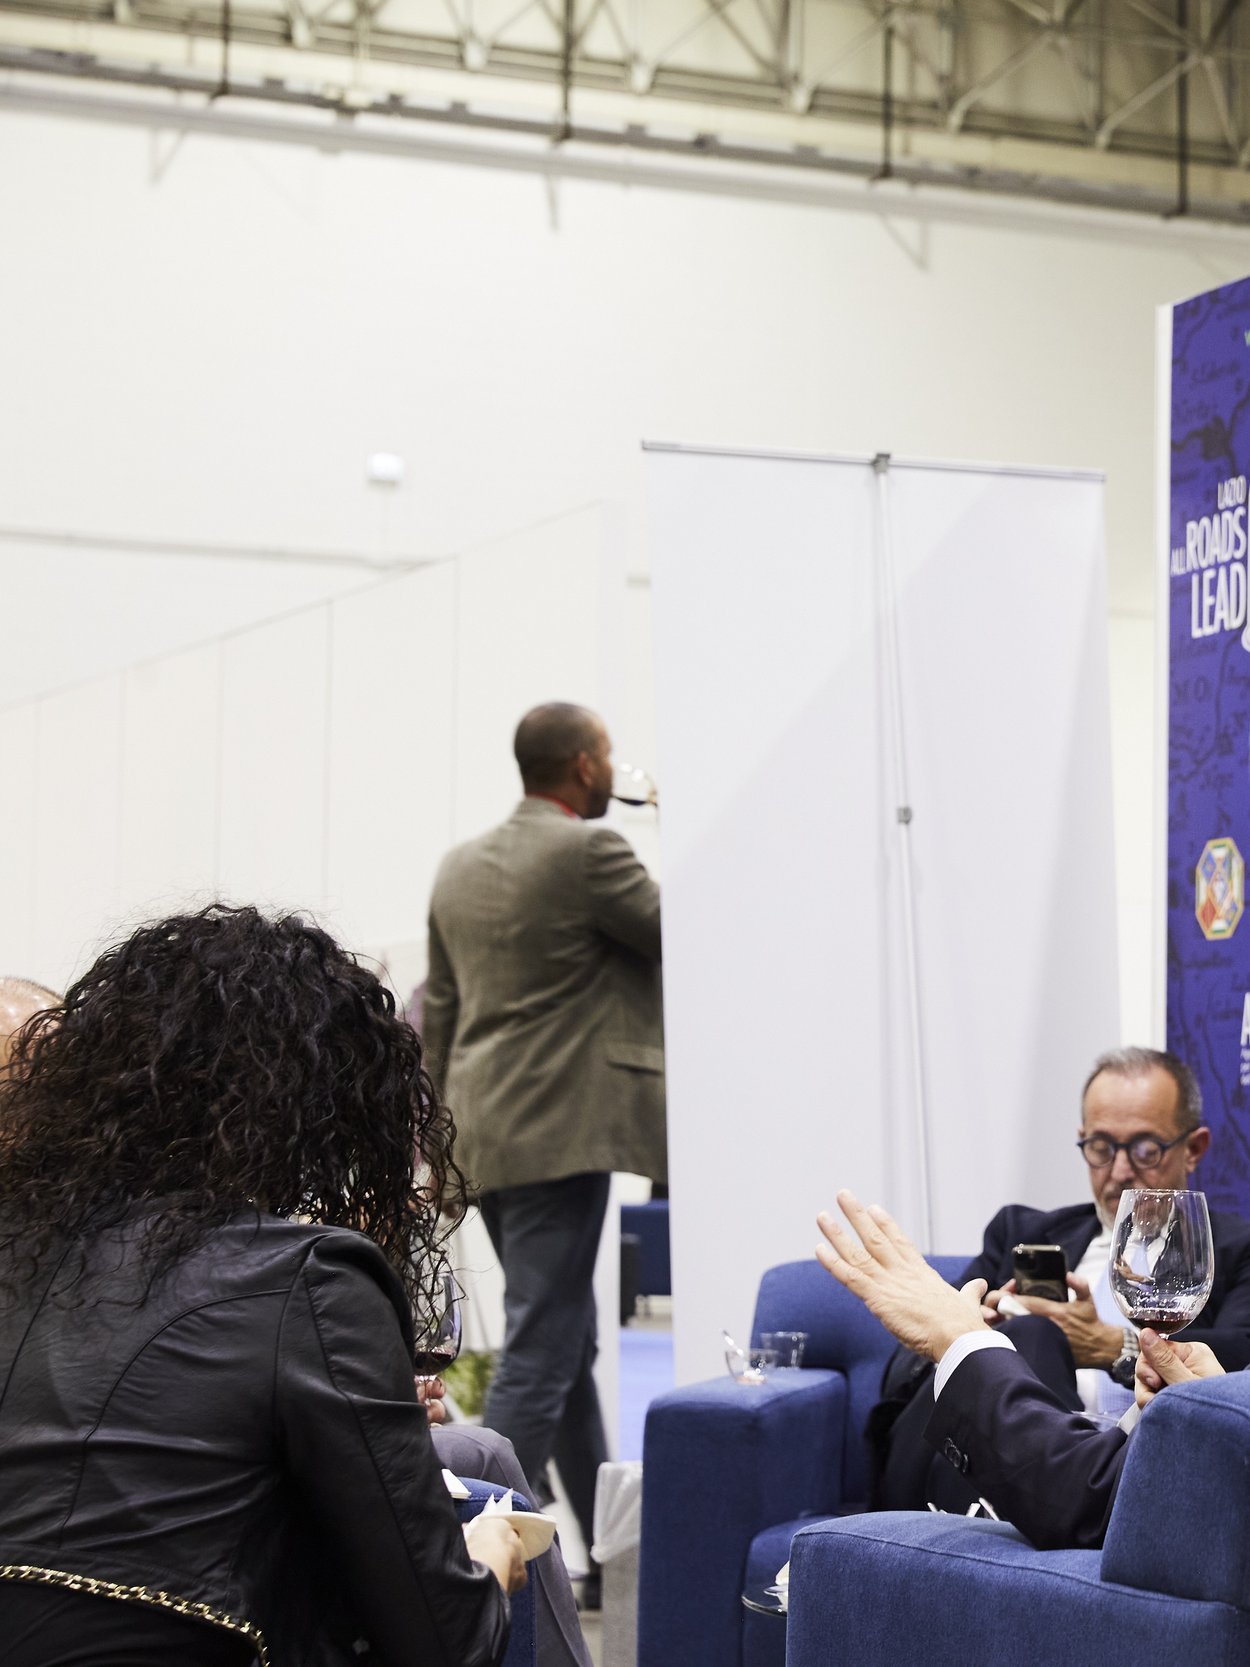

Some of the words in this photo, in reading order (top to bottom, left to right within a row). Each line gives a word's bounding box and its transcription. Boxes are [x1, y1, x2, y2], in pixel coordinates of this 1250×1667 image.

[1217, 475, 1246, 510] LAZIO
[1186, 506, 1247, 572] ROADS
[1191, 562, 1247, 638] LEAD
